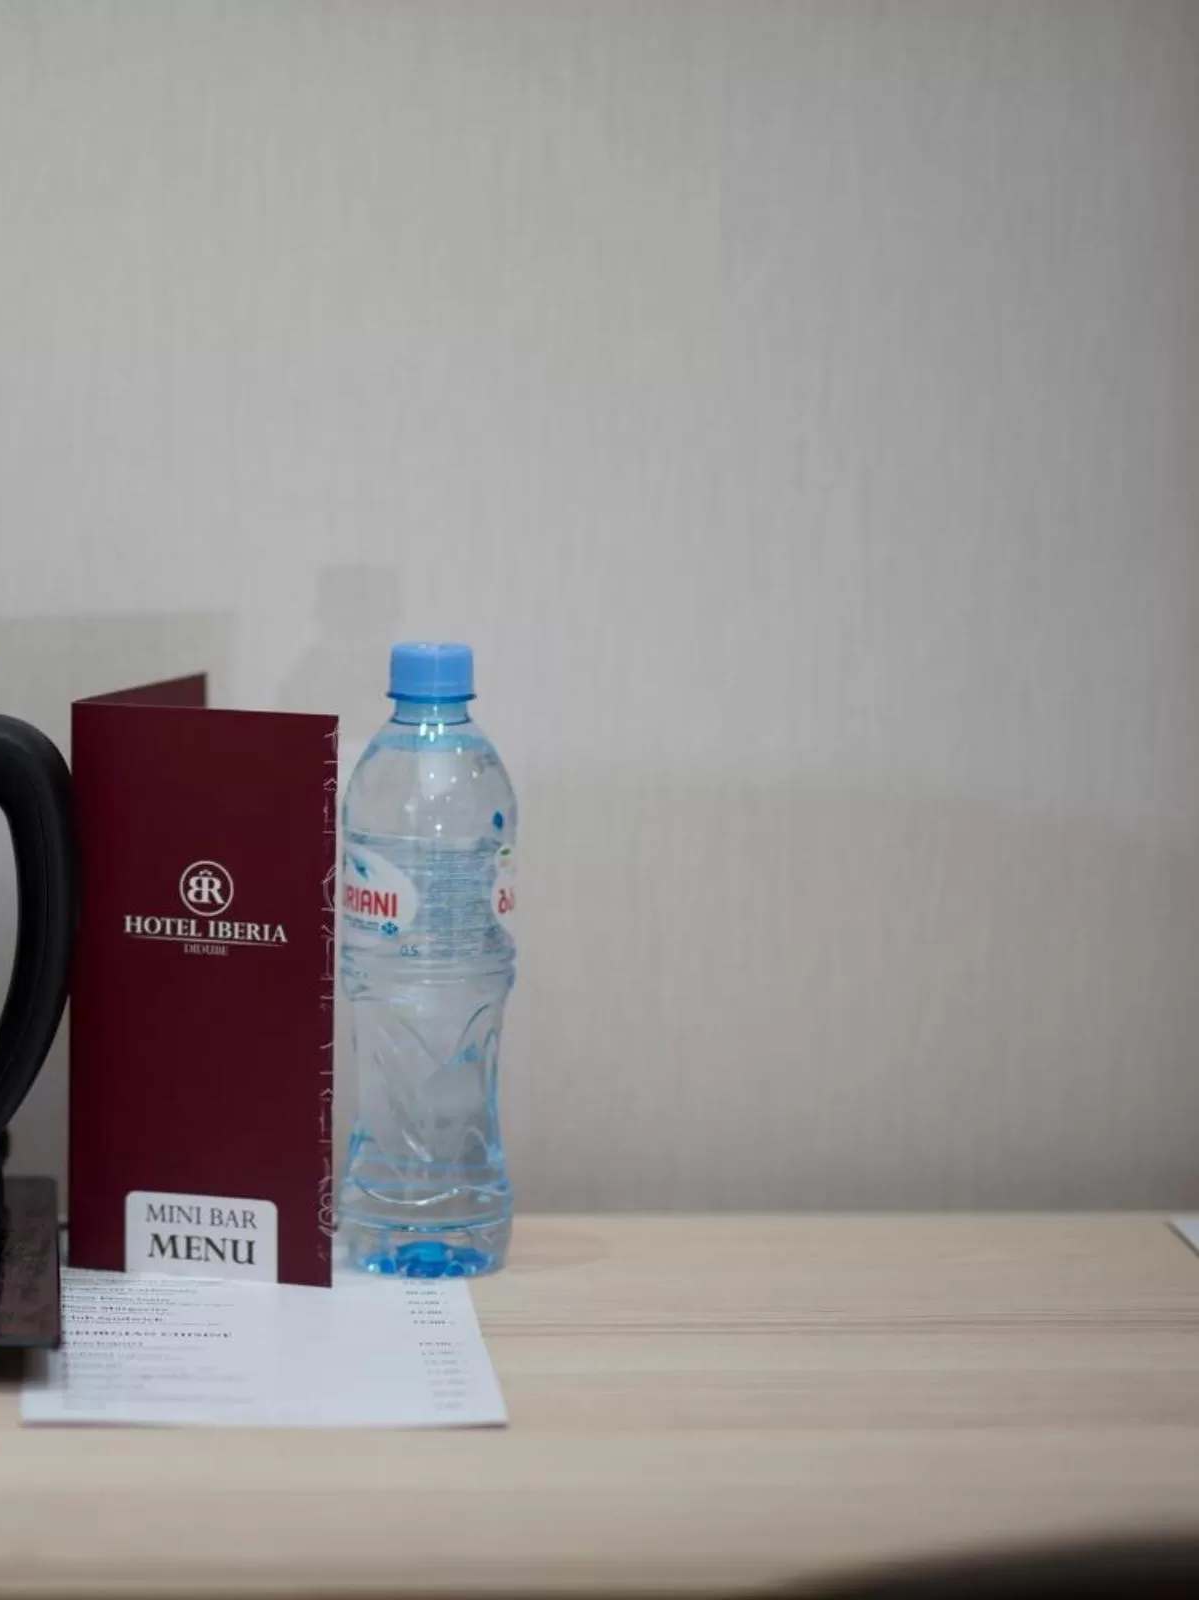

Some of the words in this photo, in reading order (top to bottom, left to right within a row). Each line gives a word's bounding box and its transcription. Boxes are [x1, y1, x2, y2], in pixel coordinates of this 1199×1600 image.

[344, 886, 398, 918] RIANI
[124, 915, 202, 937] HOTEL
[208, 920, 288, 943] IBERIA
[146, 1203, 202, 1225] MINI
[209, 1207, 258, 1230] BAR
[148, 1232, 256, 1265] MENU
